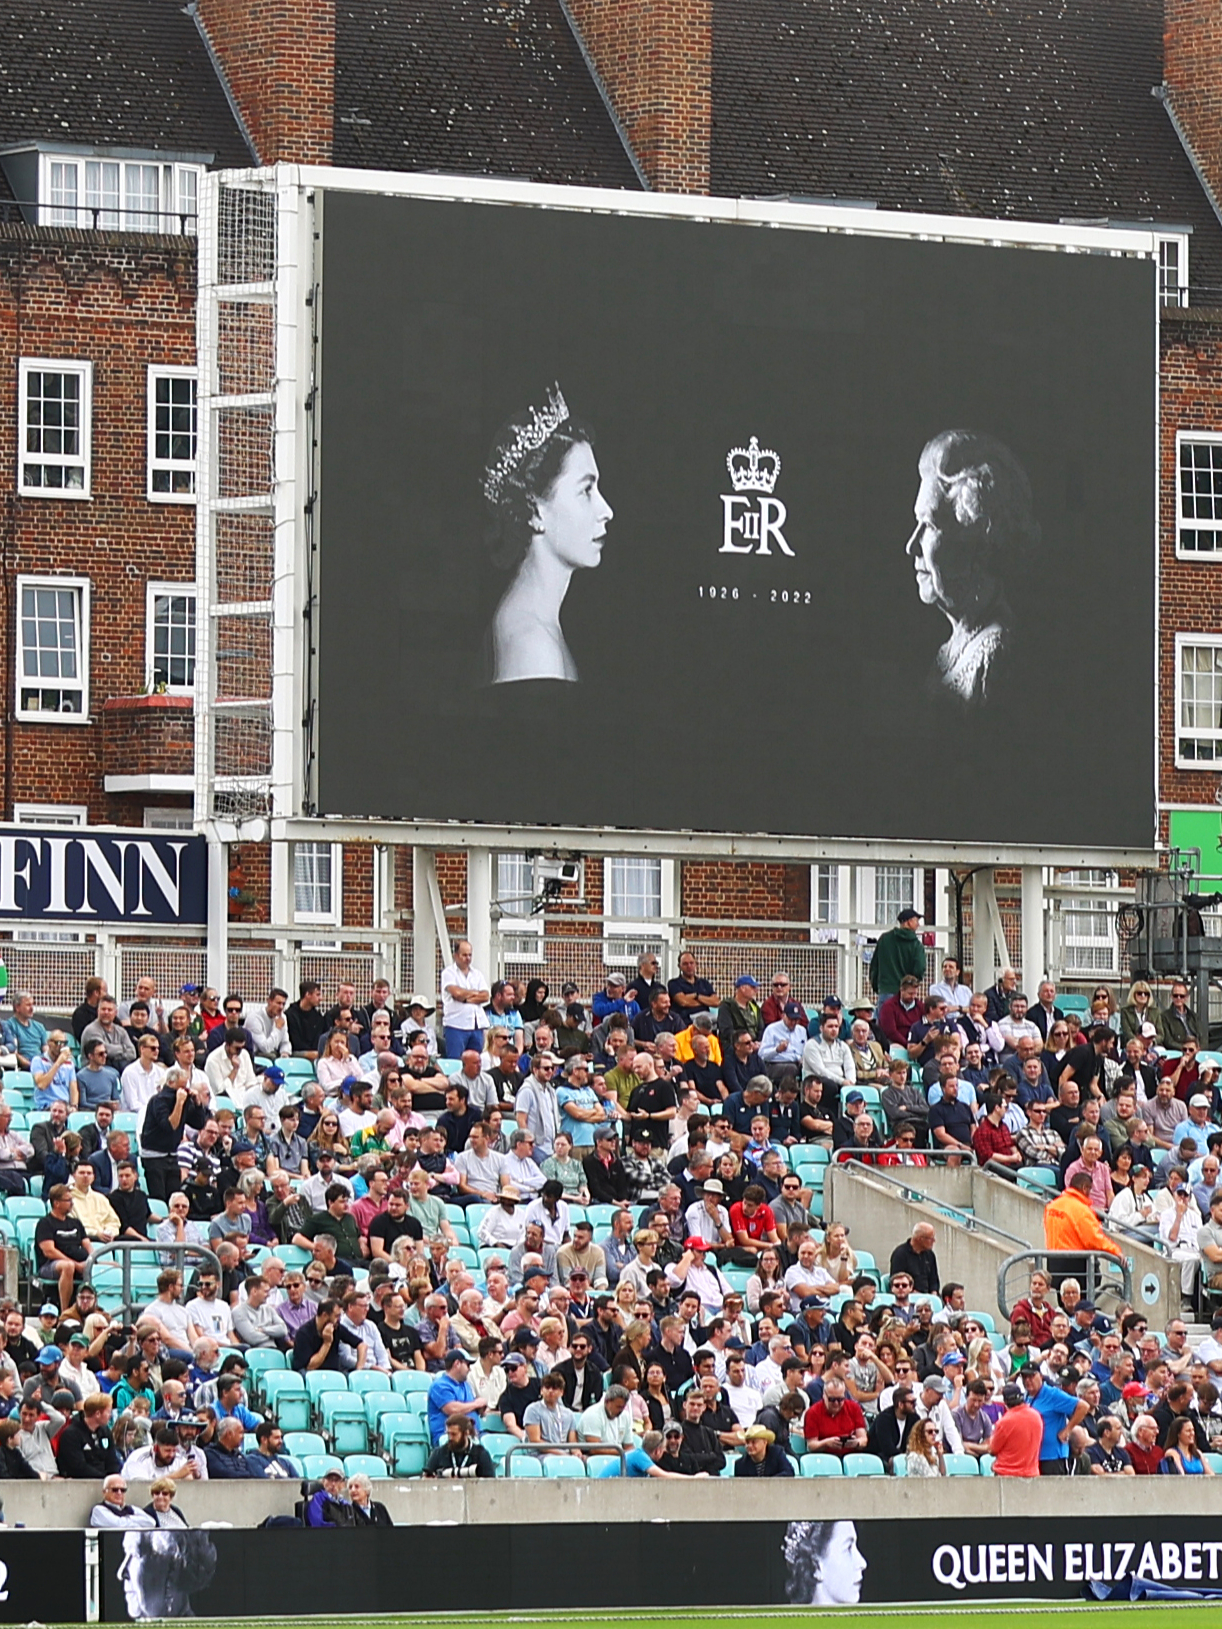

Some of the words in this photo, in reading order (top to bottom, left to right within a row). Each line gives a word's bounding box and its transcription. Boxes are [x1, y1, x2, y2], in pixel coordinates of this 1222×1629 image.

[770, 589, 812, 604] 2022
[0, 835, 189, 917] FINN
[932, 1543, 1054, 1589] QUEEN
